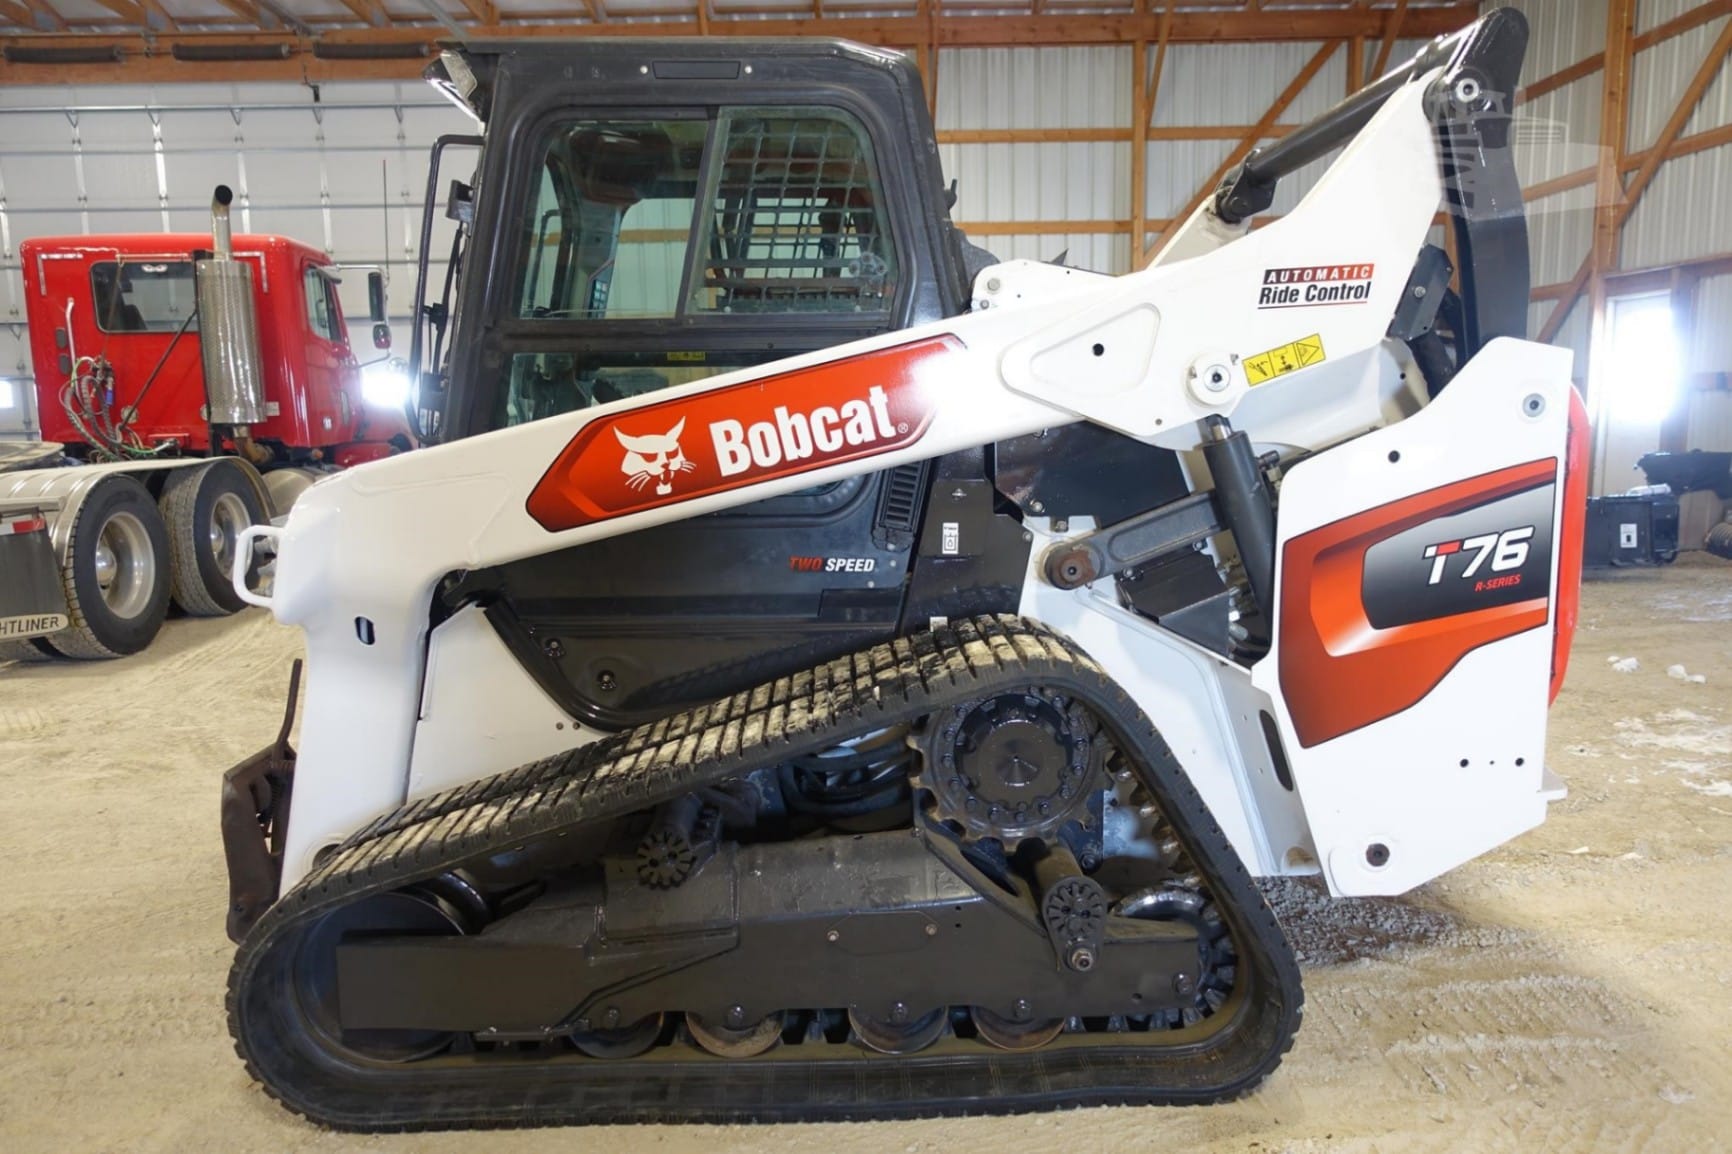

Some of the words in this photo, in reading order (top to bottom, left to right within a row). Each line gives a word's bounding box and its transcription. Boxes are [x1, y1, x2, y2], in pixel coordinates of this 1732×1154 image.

[1267, 266, 1370, 283] AUTOMATIC
[1259, 286, 1300, 304] Ride
[1305, 281, 1371, 302] Control
[789, 556, 823, 571] TWO
[825, 558, 875, 572] SPEED
[1423, 525, 1535, 585] T76
[1475, 574, 1521, 592] R-SERIES
